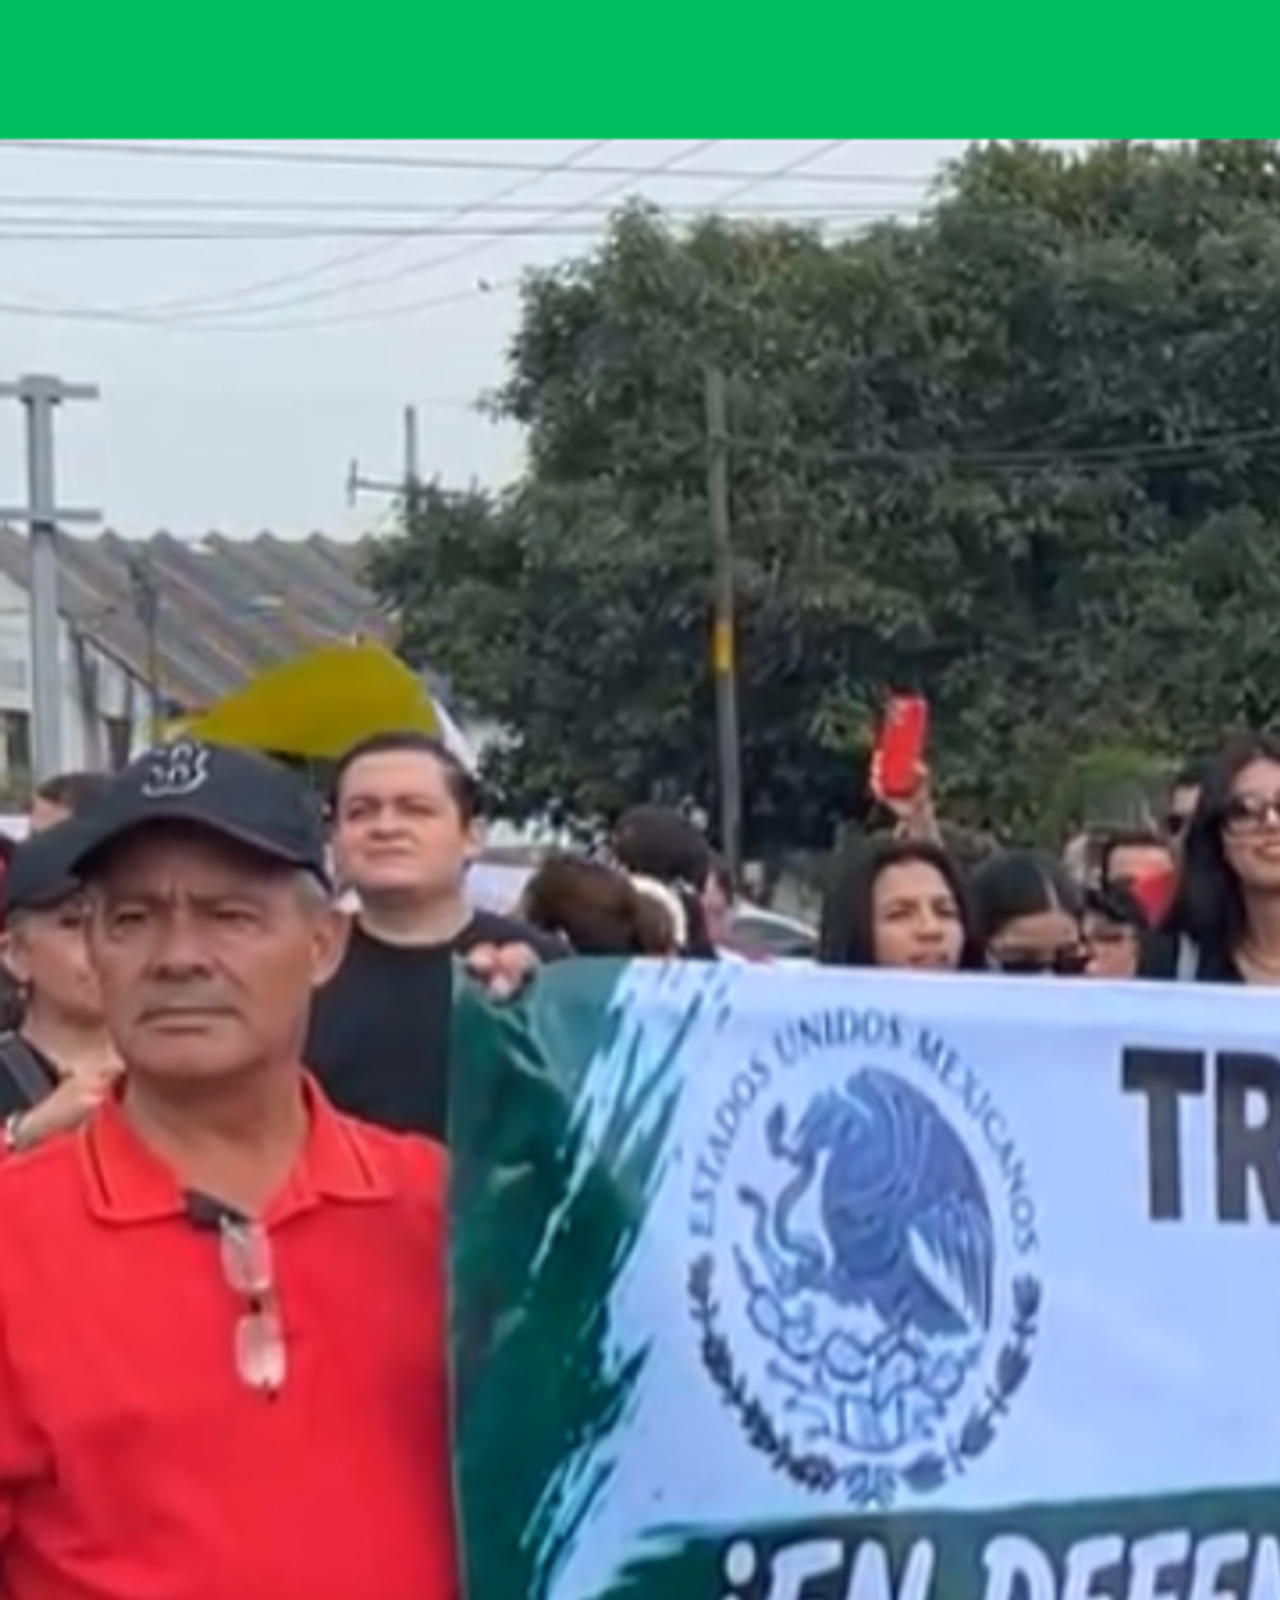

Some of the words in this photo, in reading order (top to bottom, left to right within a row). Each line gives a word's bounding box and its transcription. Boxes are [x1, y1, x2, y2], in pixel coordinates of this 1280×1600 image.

[690, 1055, 772, 1240] ESTADOS
[774, 1007, 905, 1068] UNIDOS
[911, 1028, 1040, 1255] MEXICANOS
